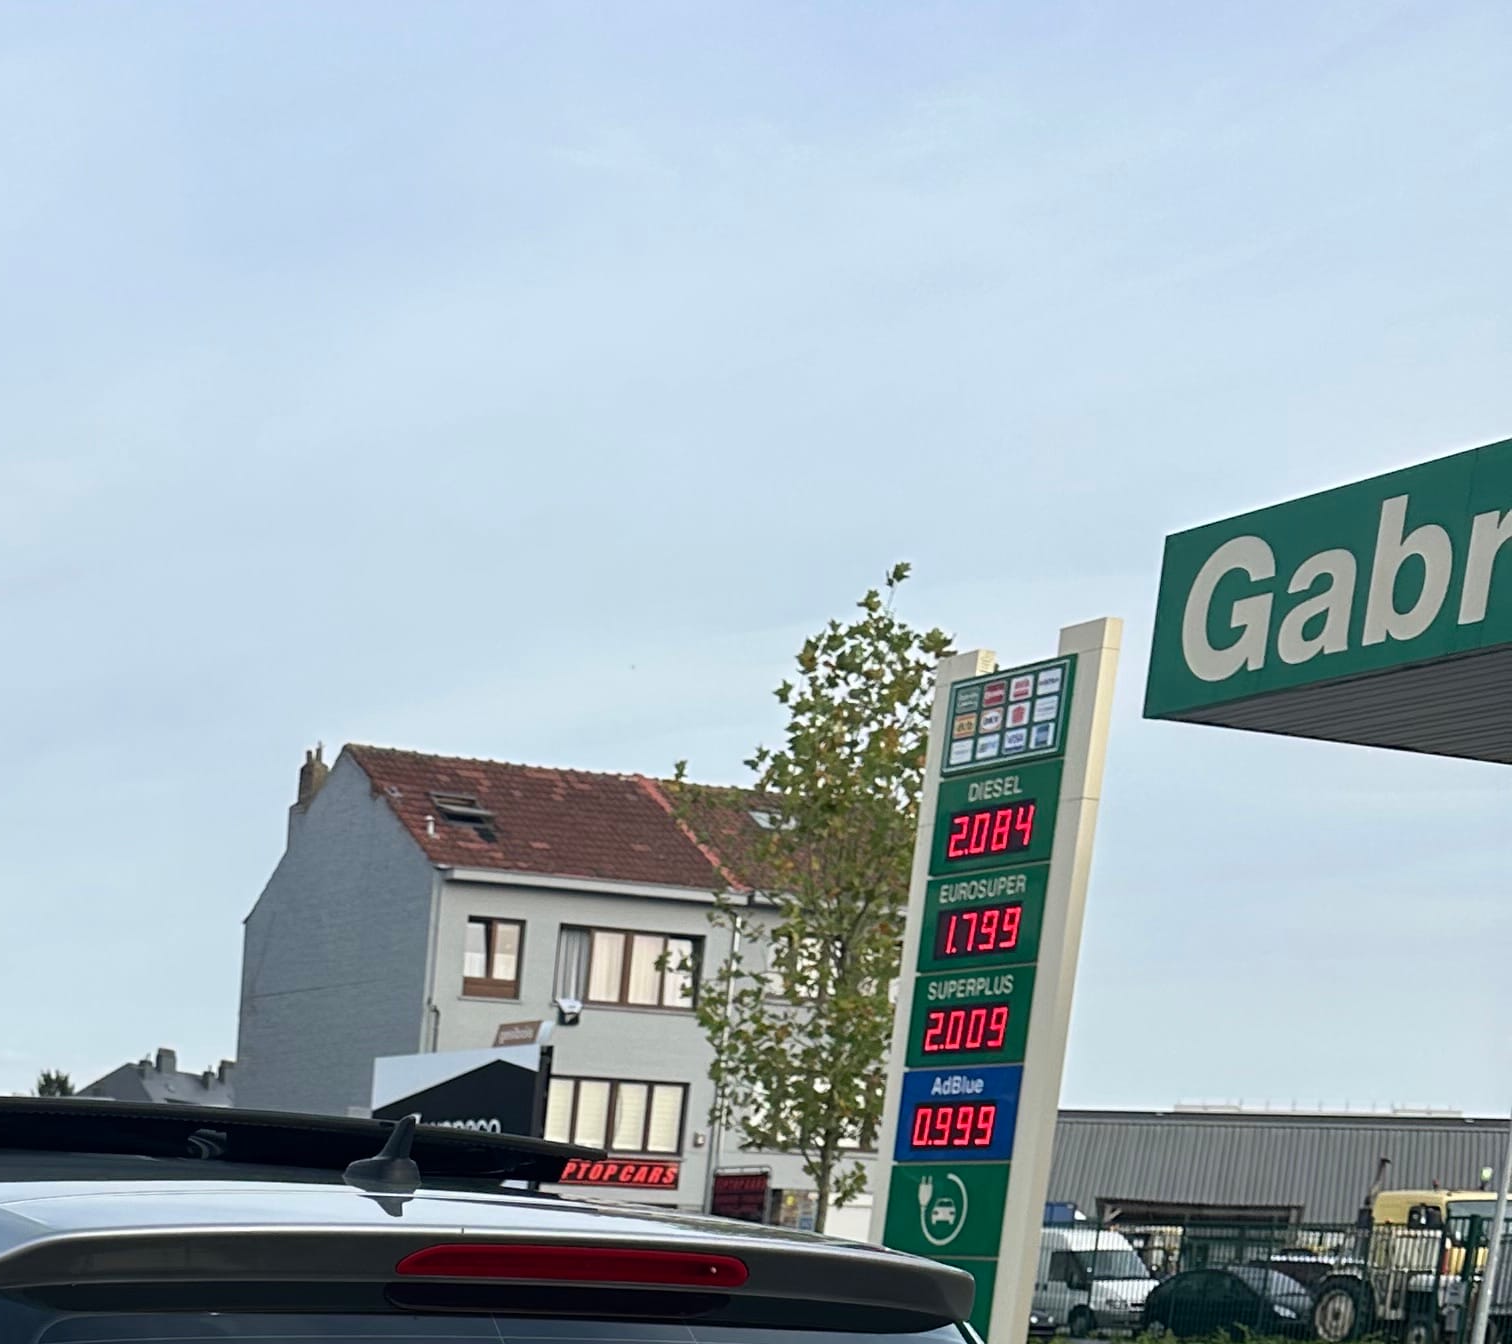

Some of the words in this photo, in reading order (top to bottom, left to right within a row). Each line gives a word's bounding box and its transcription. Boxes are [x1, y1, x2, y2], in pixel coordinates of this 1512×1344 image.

[968, 775, 1023, 803] DIESEL
[948, 804, 1036, 858] 2.084
[939, 874, 1026, 904] EUROSUPER
[945, 906, 1022, 954] 1.799
[927, 974, 1014, 1001] SUPERPLUS
[924, 1006, 1009, 1051] 2.009
[931, 1076, 985, 1096] AdBlue
[912, 1105, 996, 1147] 0.999
